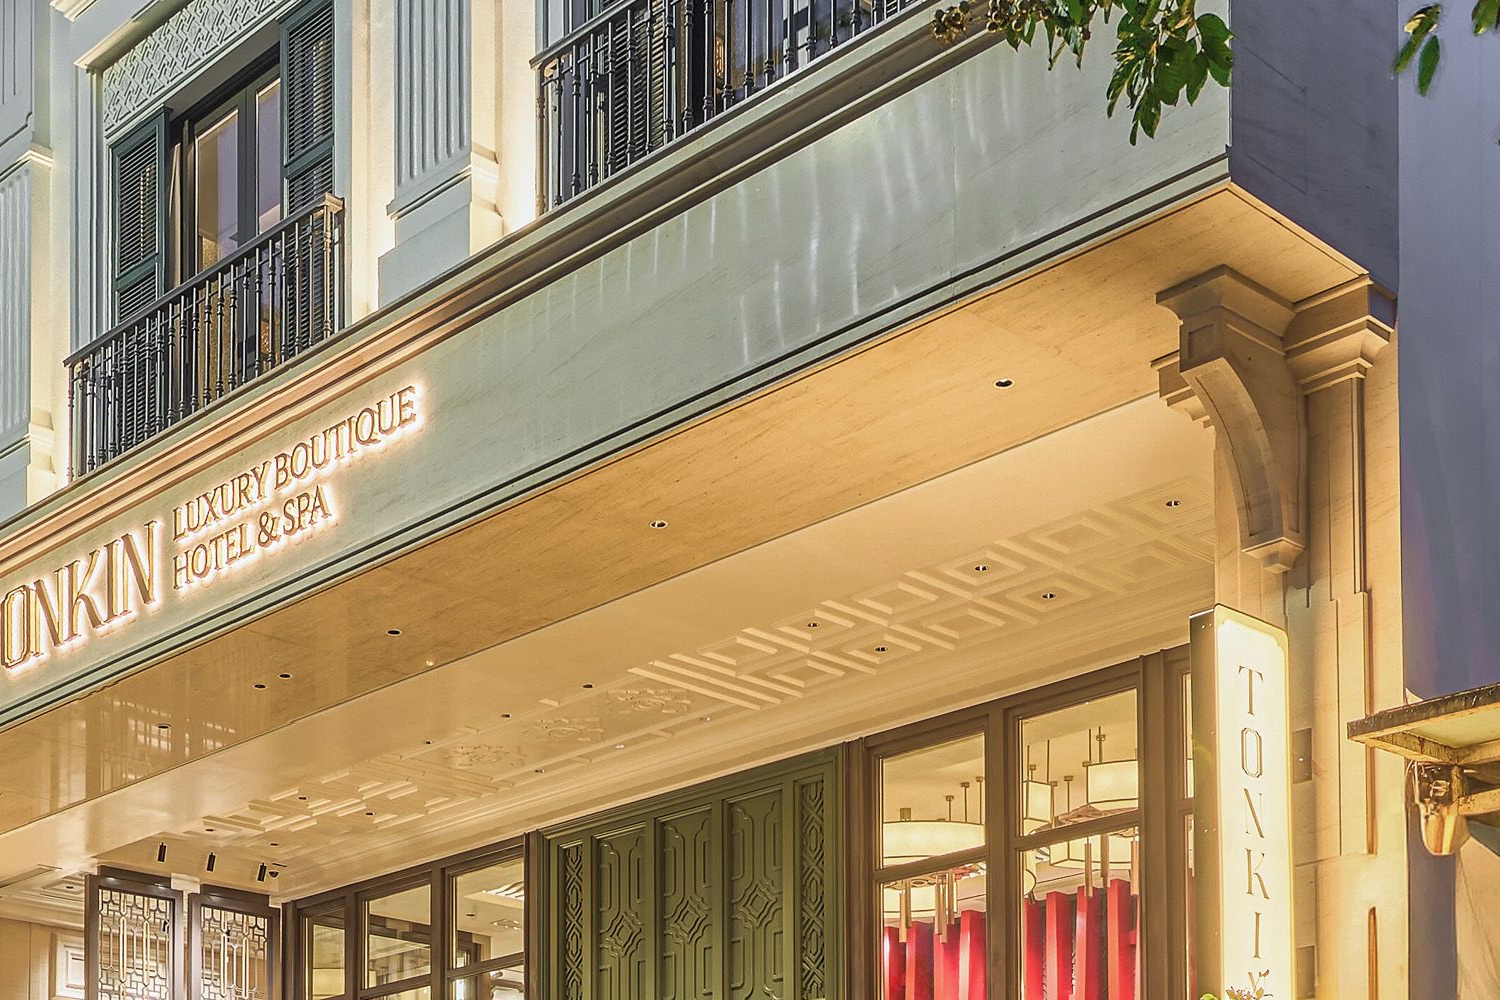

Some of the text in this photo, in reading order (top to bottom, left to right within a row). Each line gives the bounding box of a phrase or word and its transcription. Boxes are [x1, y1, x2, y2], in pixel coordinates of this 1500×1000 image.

[172, 385, 417, 542] LUXURY BOUTIQUE
[172, 484, 333, 590] HOTEL & SPA
